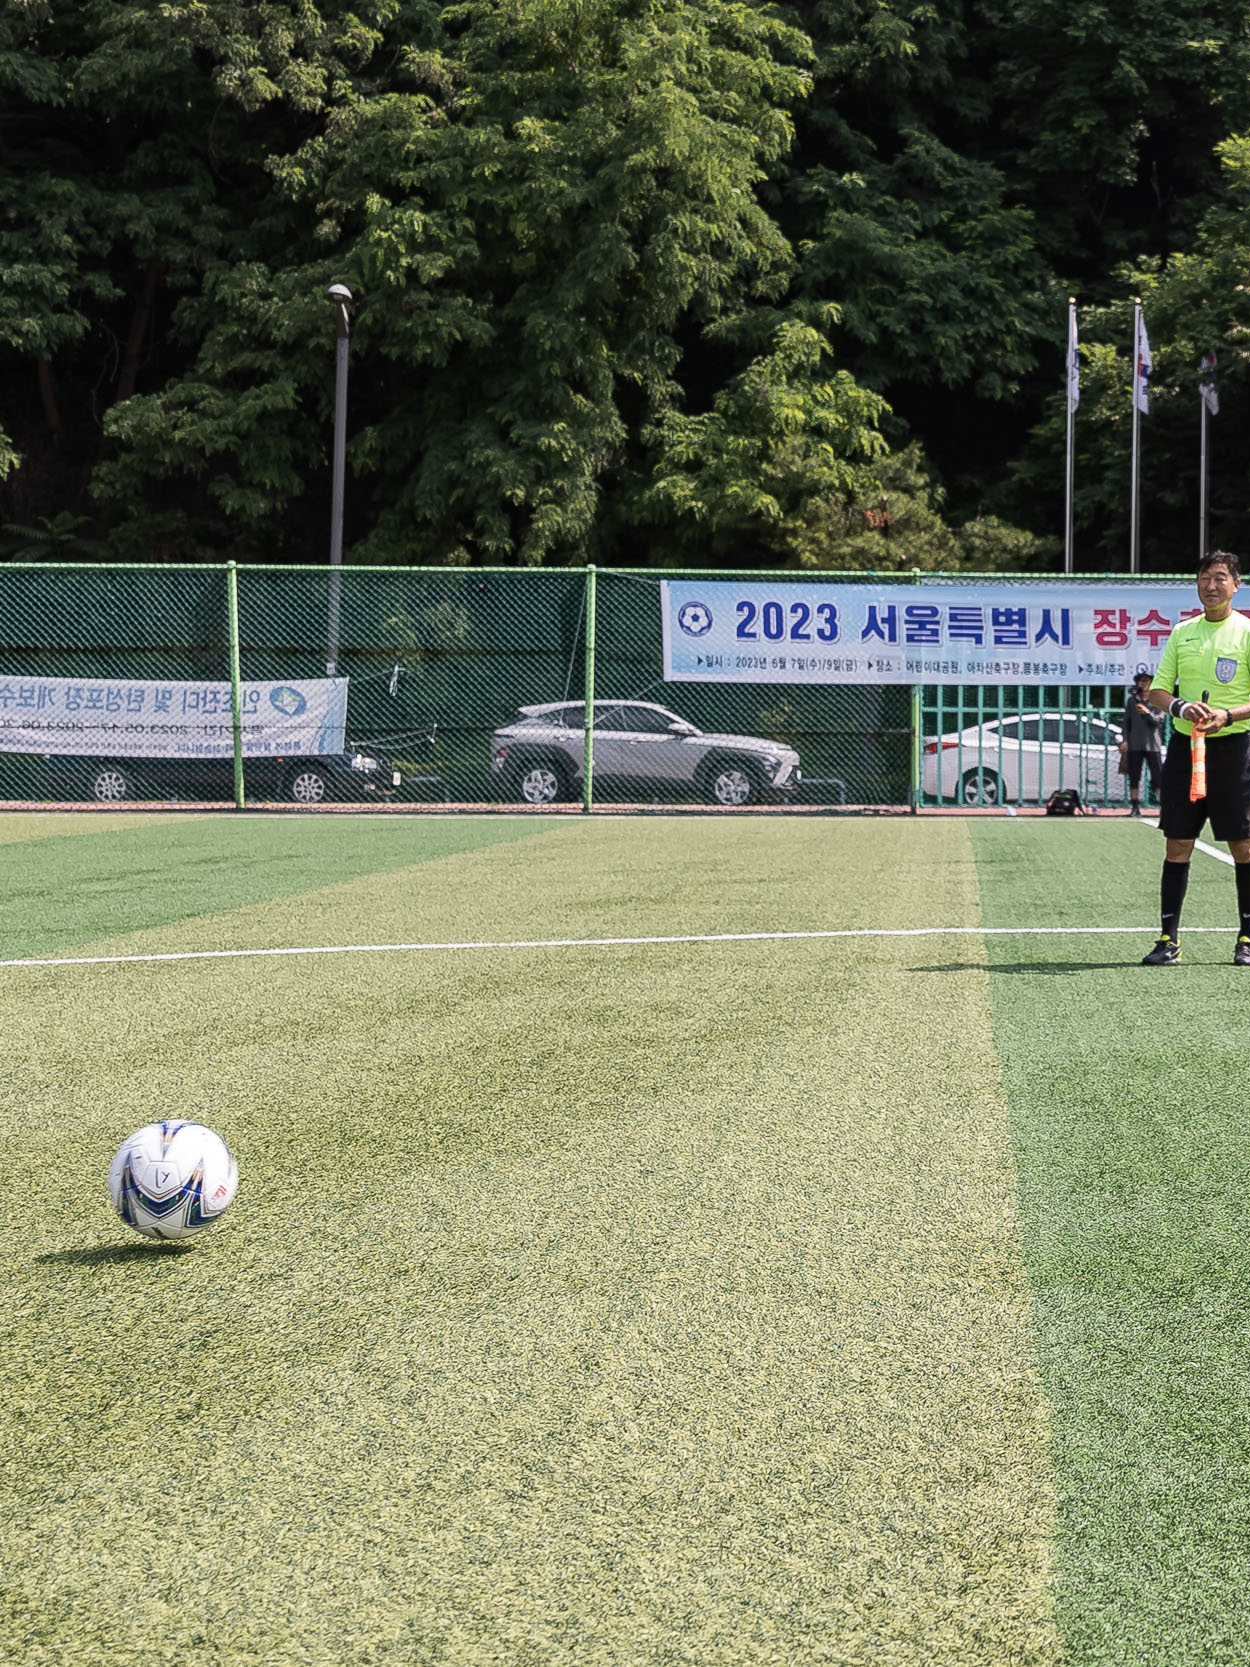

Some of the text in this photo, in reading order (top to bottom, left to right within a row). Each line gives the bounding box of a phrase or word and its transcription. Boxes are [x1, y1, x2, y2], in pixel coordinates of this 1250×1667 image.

[736, 600, 839, 641] 2023
[862, 604, 1069, 646] 서울특별시
[705, 655, 723, 669] 일시
[736, 656, 767, 670] 2023년
[772, 657, 787, 670] 6월
[876, 660, 893, 673] 장소
